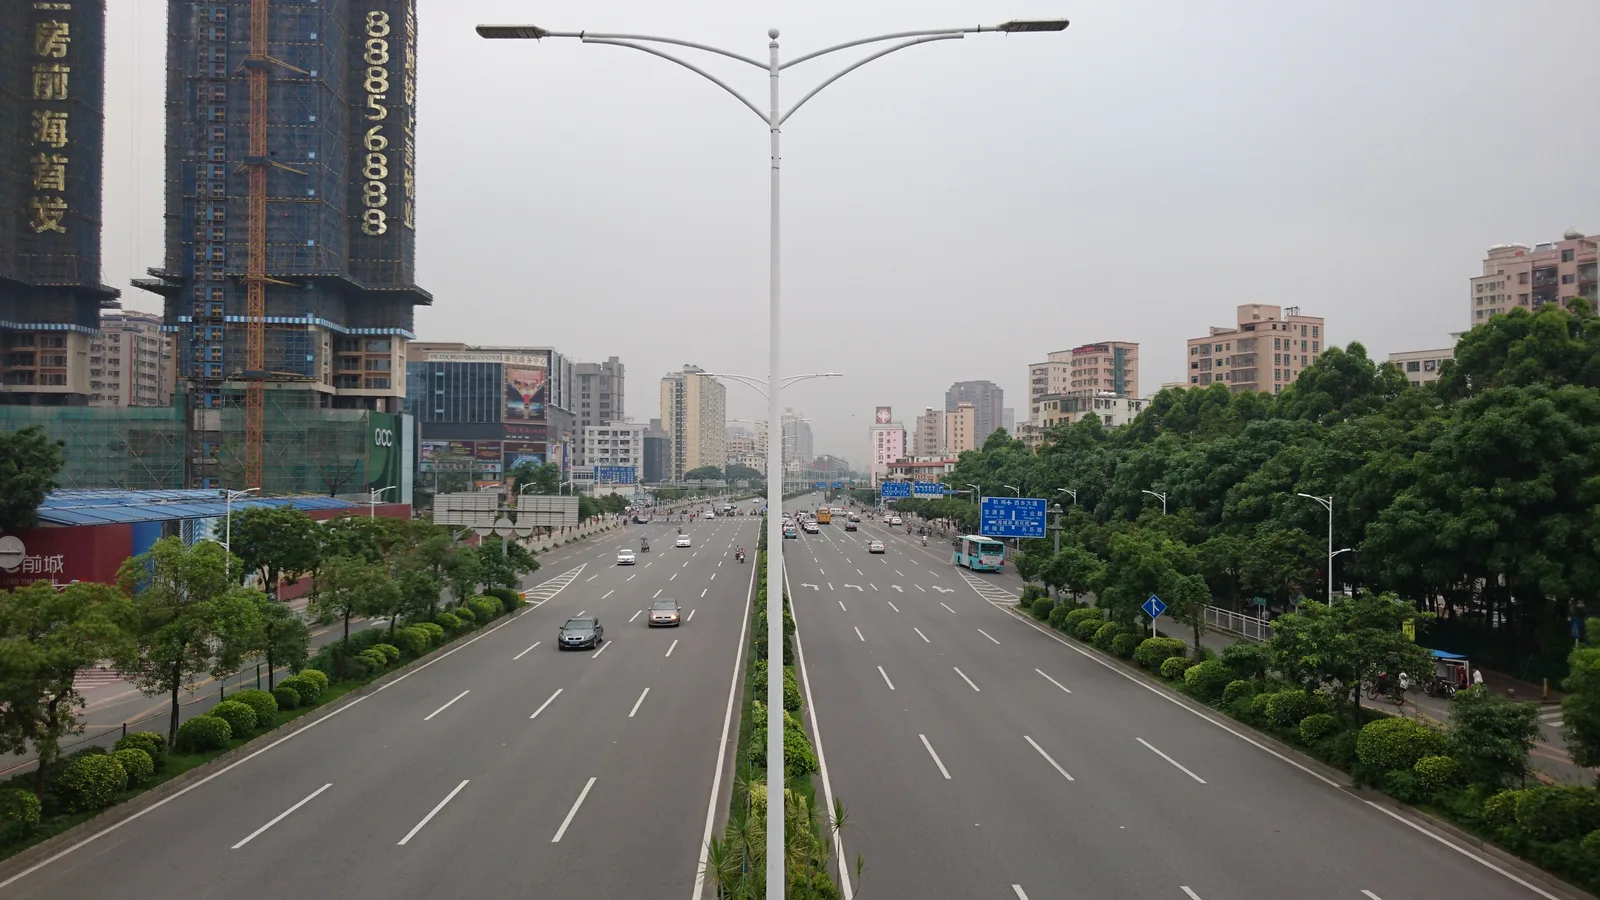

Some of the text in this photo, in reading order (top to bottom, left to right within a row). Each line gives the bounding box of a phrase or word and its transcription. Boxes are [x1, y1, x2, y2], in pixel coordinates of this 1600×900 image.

[361, 10, 390, 236] 88856888
[375, 428, 392, 447] QCC
[5, 554, 64, 573] 前城
